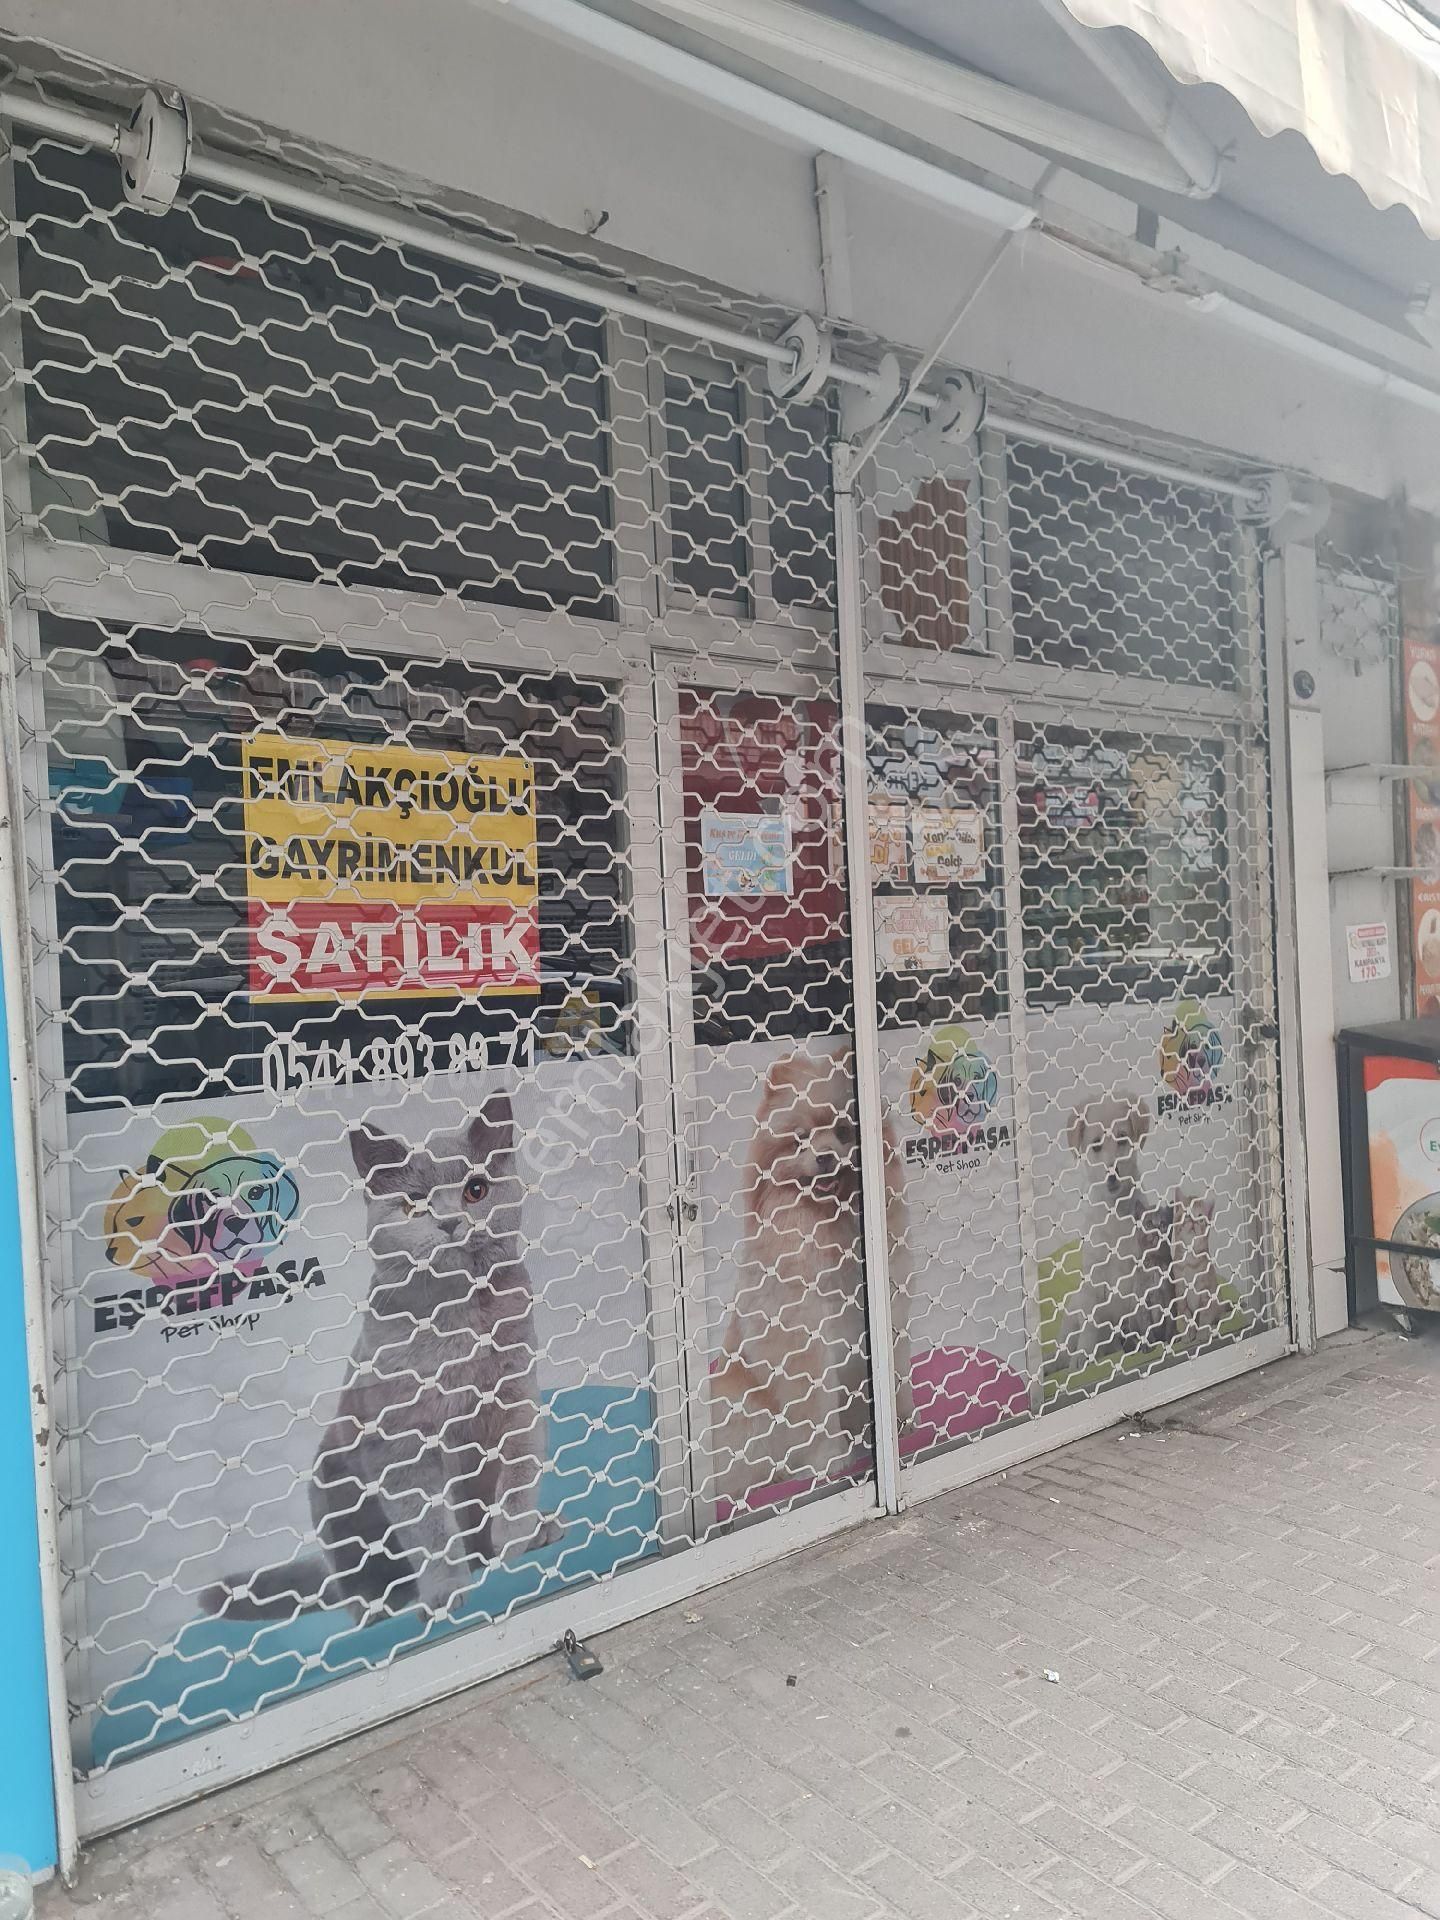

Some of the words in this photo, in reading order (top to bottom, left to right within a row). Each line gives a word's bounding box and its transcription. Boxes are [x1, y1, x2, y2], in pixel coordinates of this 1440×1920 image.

[249, 756, 531, 819] EMLAKÇIOĞLU
[250, 832, 535, 885] GAYRİMENKUL
[256, 921, 533, 974] SATILIK
[262, 1038, 353, 1099] 0541
[371, 1034, 435, 1096] 893
[500, 1029, 535, 1086] 71
[936, 1162, 955, 1174] Pet
[161, 1318, 204, 1343] Pet
